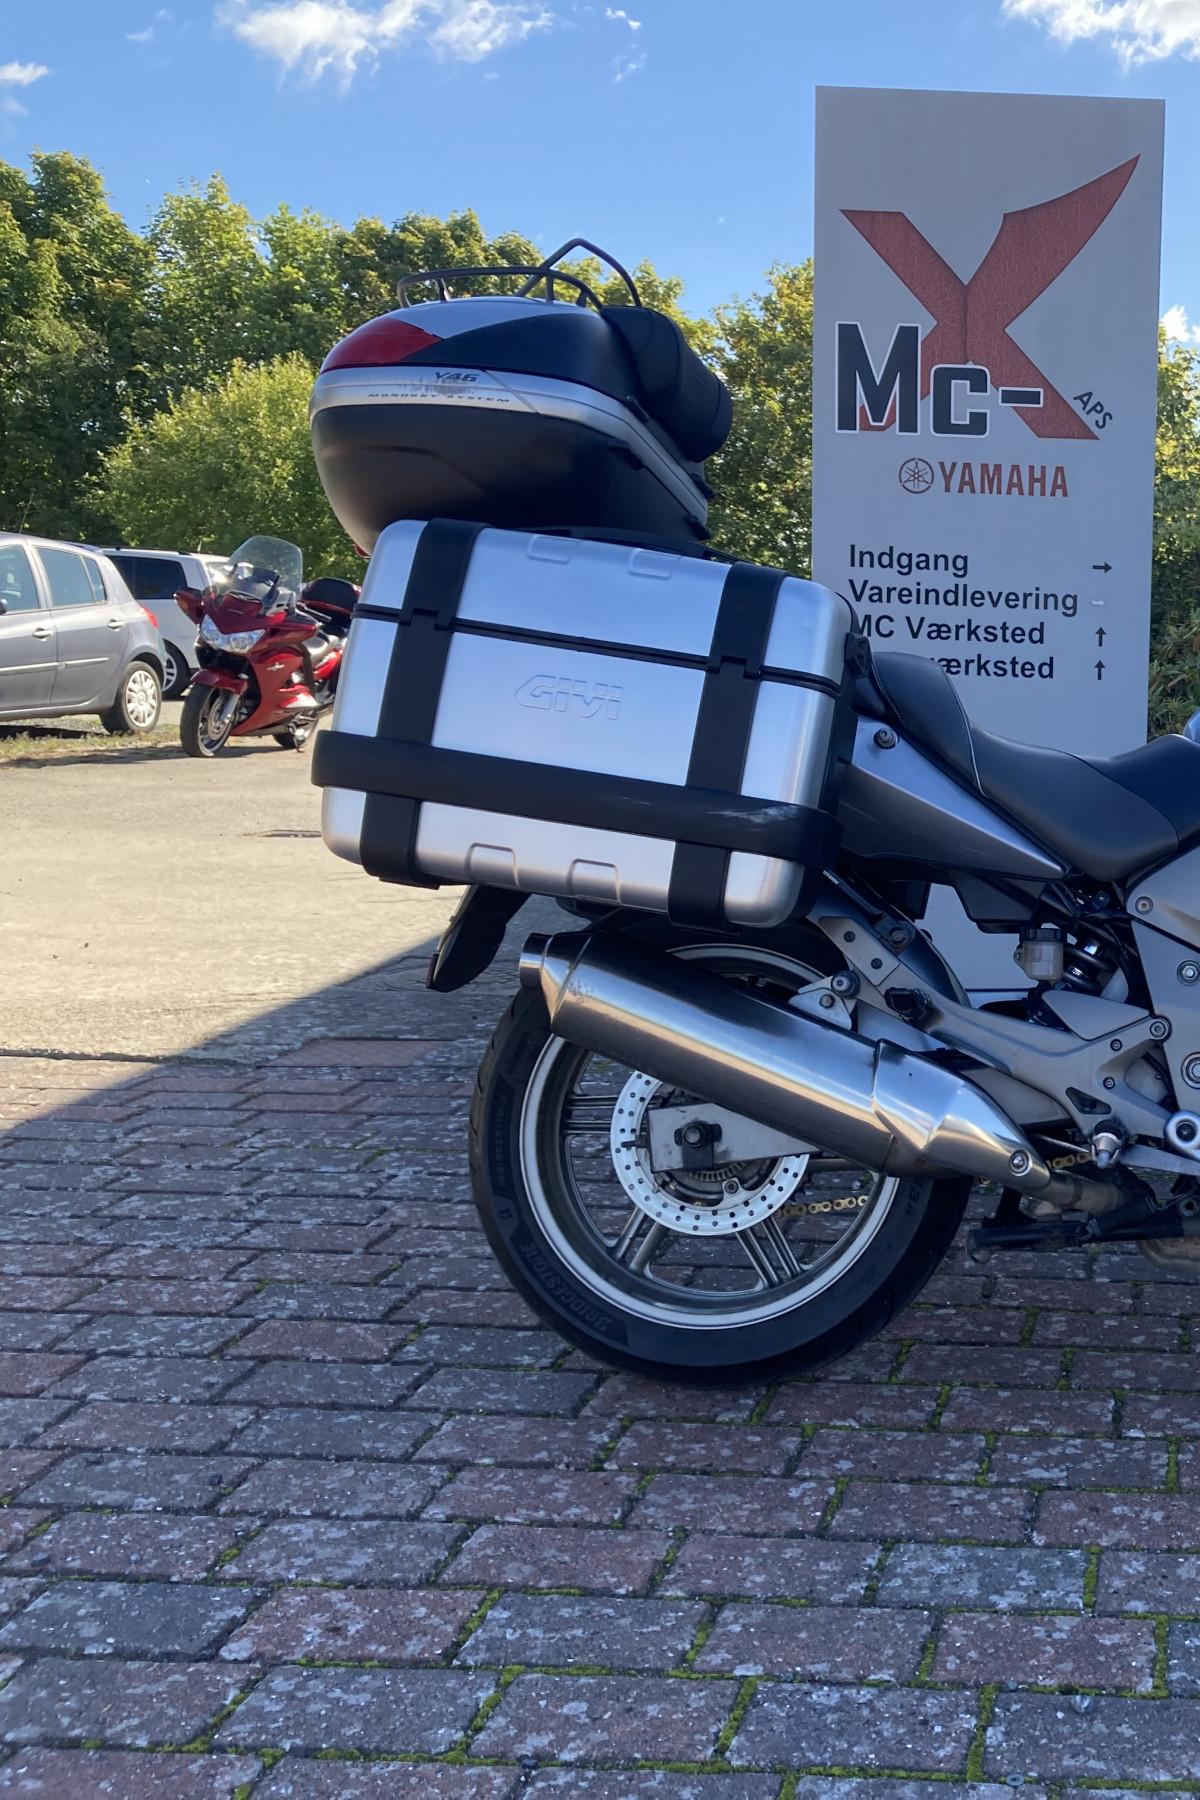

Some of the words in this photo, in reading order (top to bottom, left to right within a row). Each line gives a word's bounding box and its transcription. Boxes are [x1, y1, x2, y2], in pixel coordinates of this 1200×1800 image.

[938, 460, 1069, 498] YAMAHA
[850, 544, 969, 578] Indgang
[848, 579, 1079, 617] Vareindlevering
[905, 616, 1045, 645] Værksted
[930, 654, 1054, 679] ærksted
